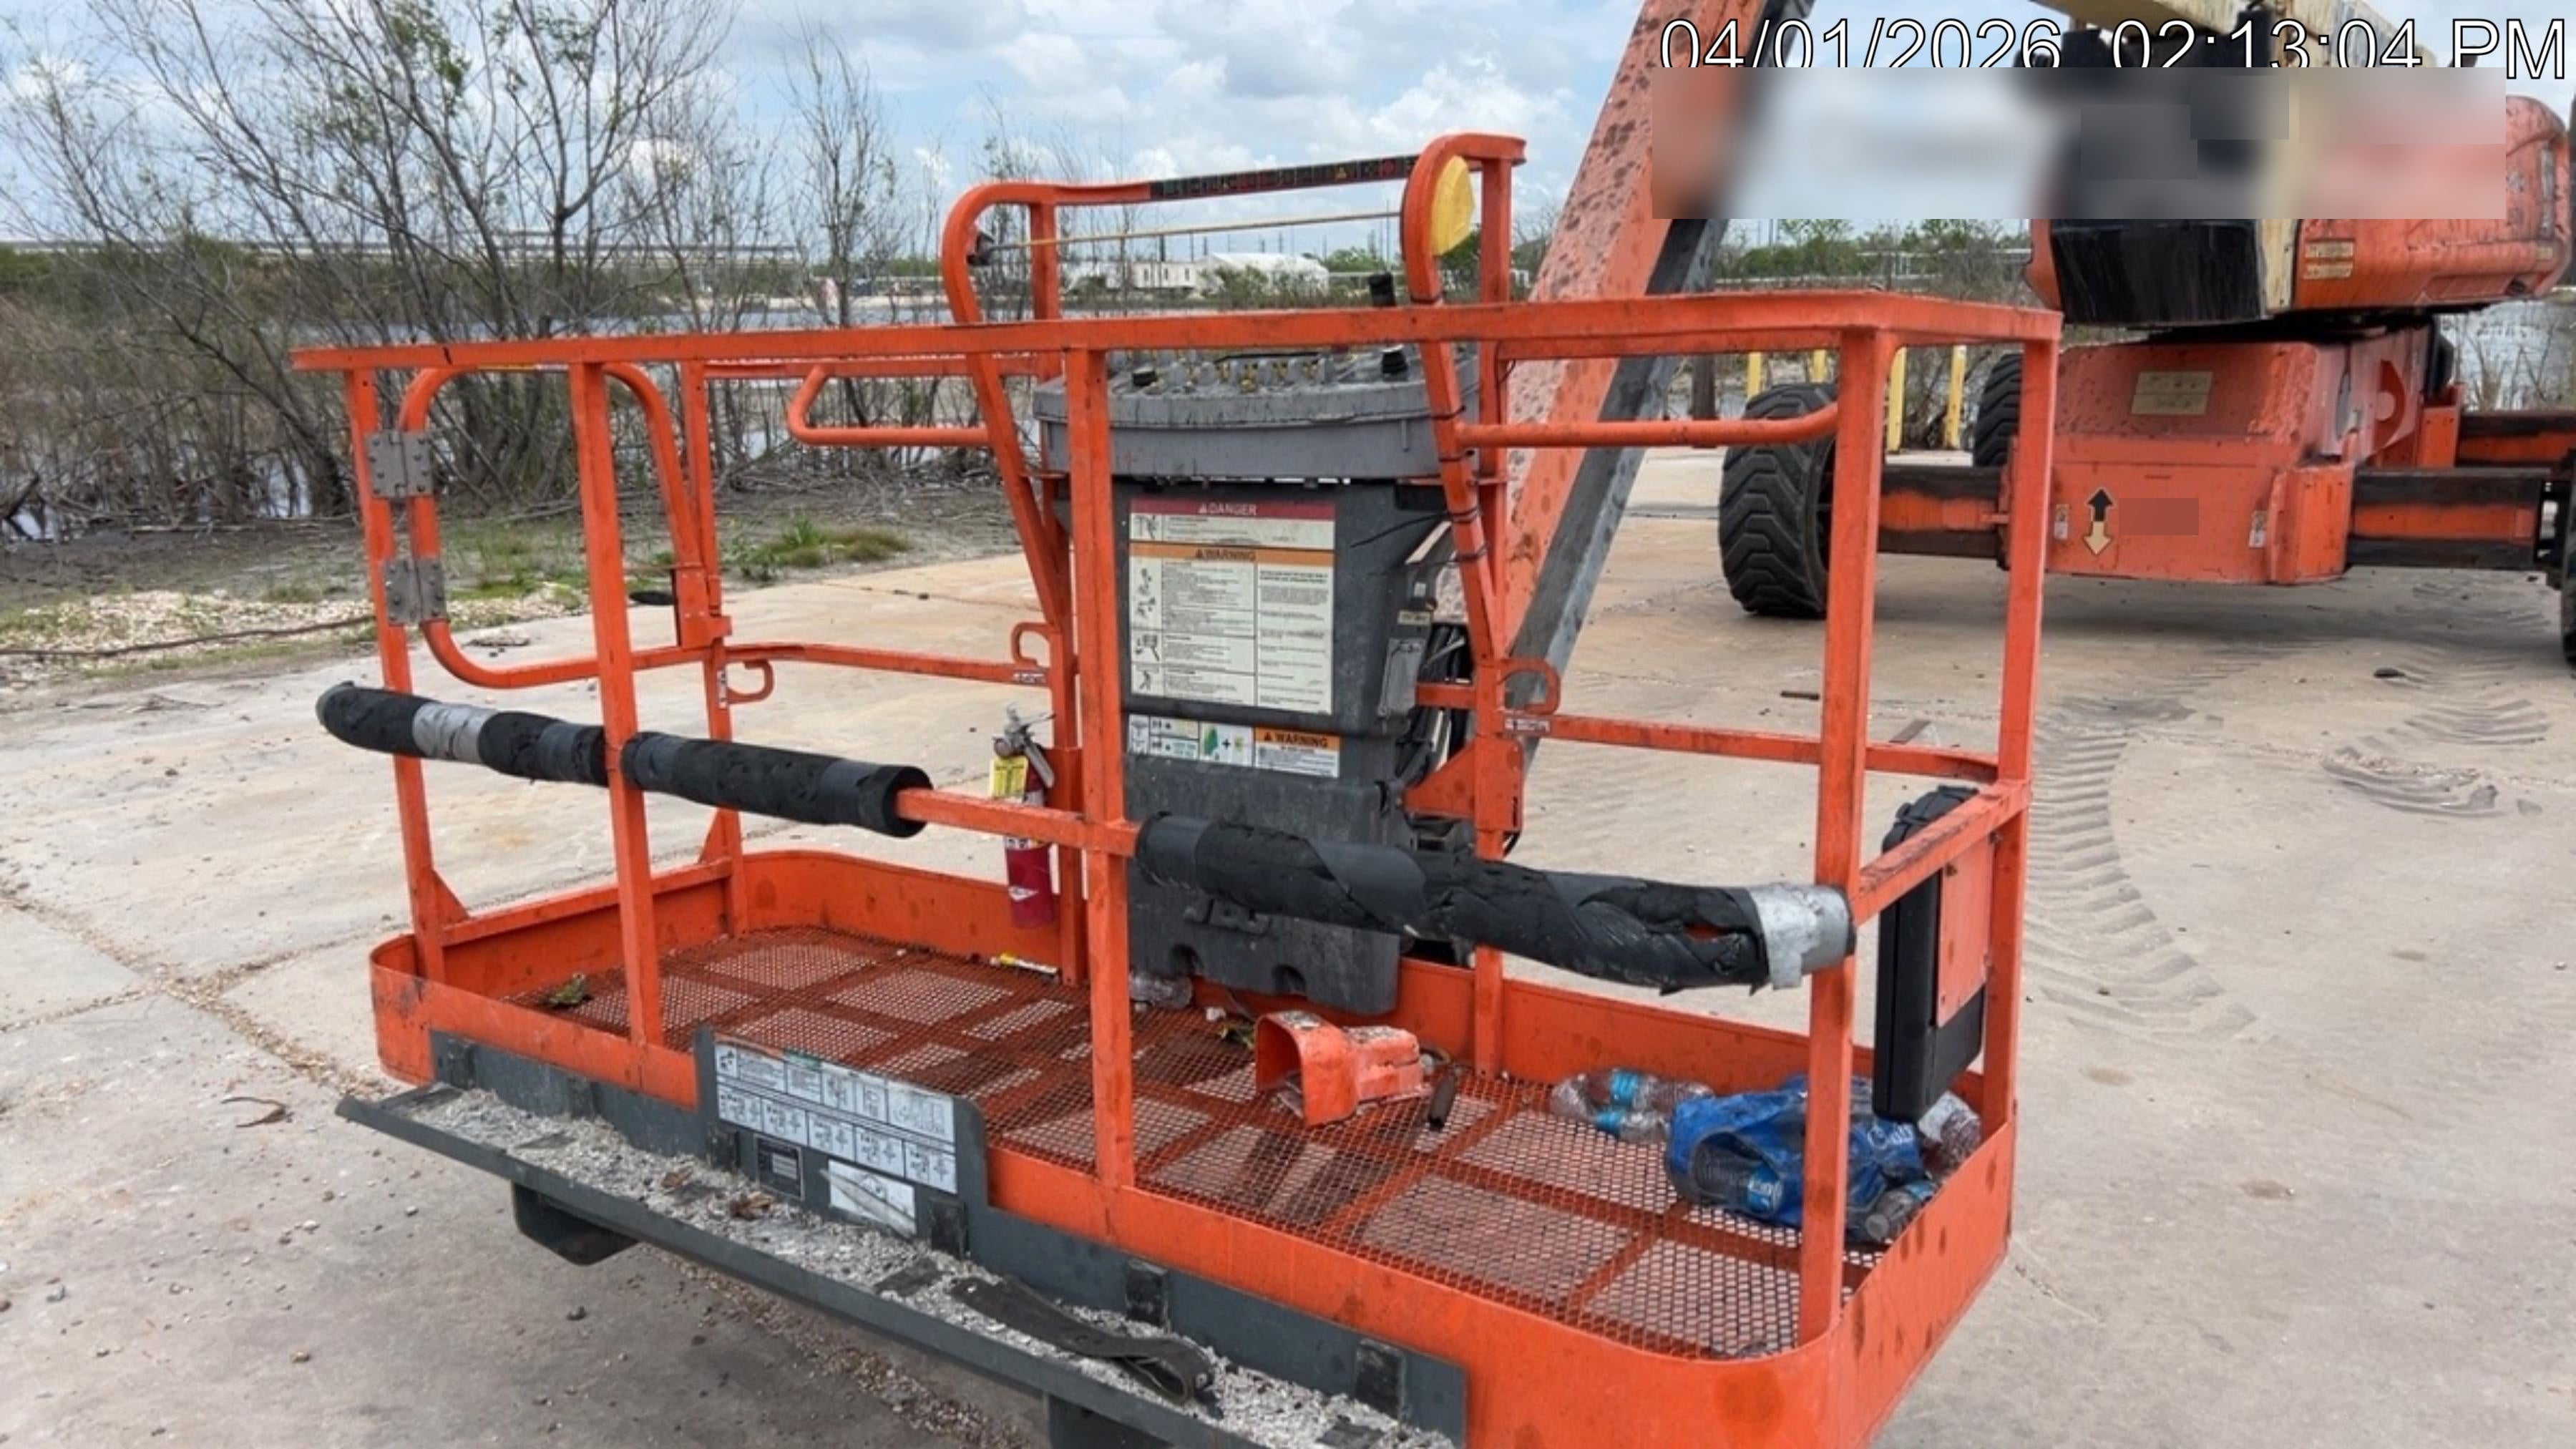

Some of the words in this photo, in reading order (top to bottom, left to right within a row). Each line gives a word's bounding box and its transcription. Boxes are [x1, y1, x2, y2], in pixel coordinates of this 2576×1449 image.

[1209, 503, 1257, 516] DANGER
[1204, 549, 1257, 562] WARNING
[1276, 732, 1328, 748] WARNING
